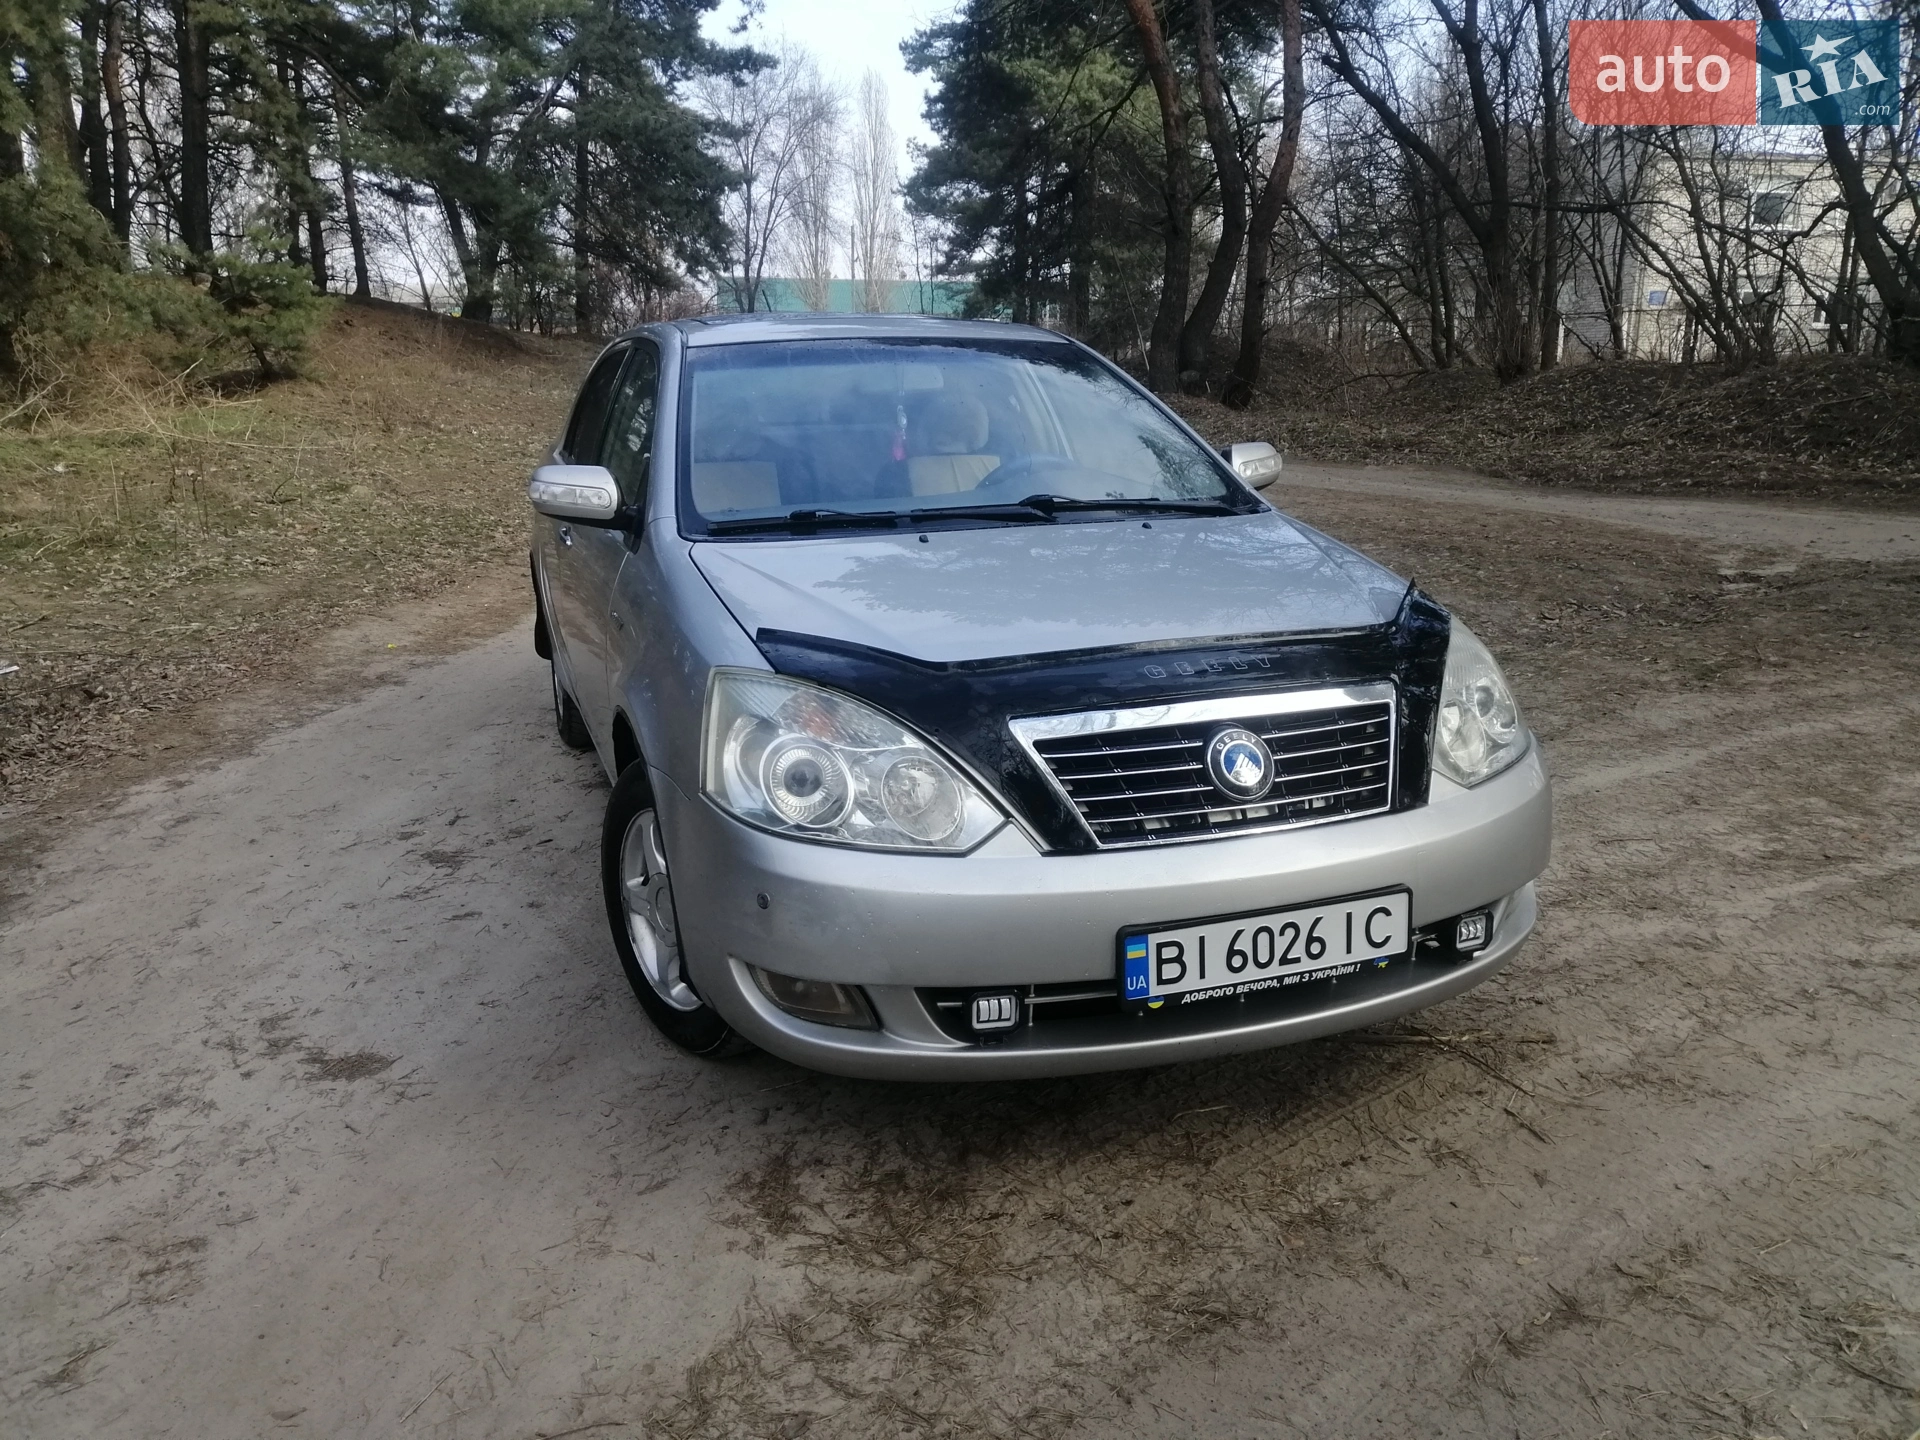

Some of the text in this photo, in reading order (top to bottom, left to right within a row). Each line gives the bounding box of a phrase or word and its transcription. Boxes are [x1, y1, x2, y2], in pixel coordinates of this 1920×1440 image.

[1144, 654, 1271, 679] GEELY
[1216, 732, 1257, 750] GEELY
[1156, 905, 1393, 987] BI 6026 IC
[1127, 974, 1147, 991] UA
[1181, 986, 1234, 1004] ДОБРОГО
[1236, 978, 1280, 994] ВЕЧОРА,
[1283, 975, 1300, 986] МИ
[1310, 965, 1354, 981] УКРАЇНИ
